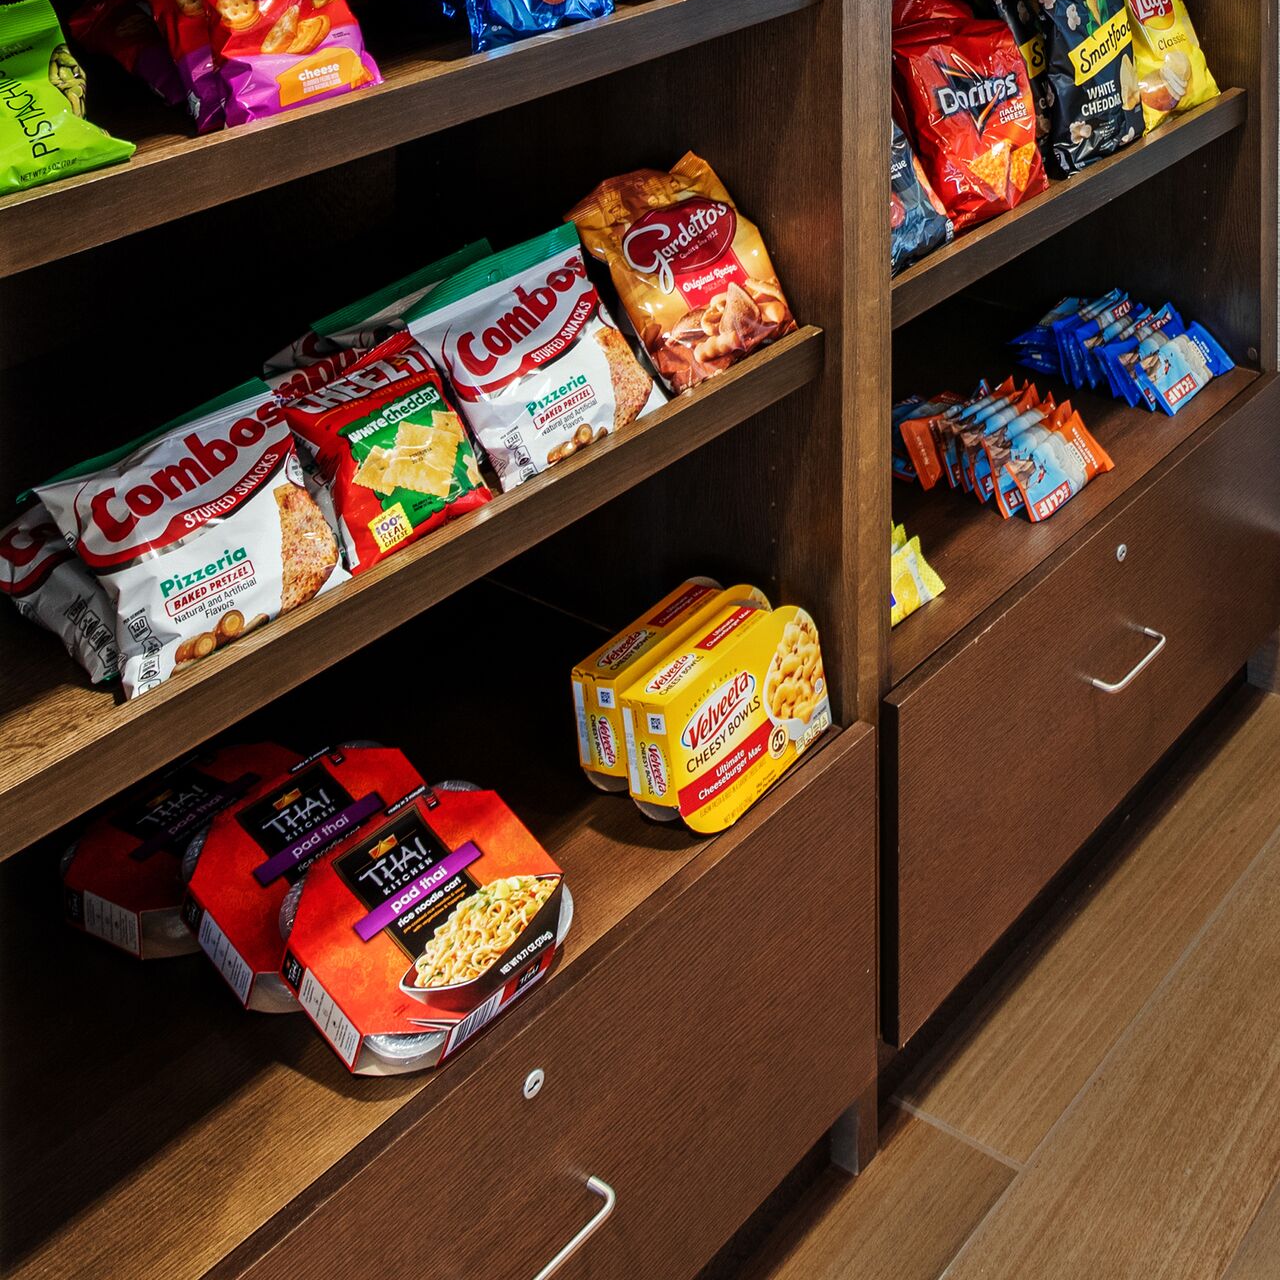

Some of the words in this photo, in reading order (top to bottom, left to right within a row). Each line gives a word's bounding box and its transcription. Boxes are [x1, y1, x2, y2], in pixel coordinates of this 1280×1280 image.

[299, 62, 340, 83] cheese
[937, 73, 1018, 116] Doritos
[1087, 80, 1116, 100] WHITE
[623, 203, 727, 295] Gardetto's
[683, 272, 714, 292] Original
[713, 264, 737, 278] Recipe
[455, 256, 586, 376] Combos
[531, 337, 566, 364] STUFFED
[560, 301, 591, 341] SNACKS
[526, 374, 587, 416] Pizzeria
[540, 405, 562, 424] BAKED
[564, 389, 590, 409] PRETZEL
[542, 419, 564, 436] Natural
[564, 414, 575, 423] and
[575, 400, 597, 415] Artificial
[563, 416, 584, 431] Flavors
[90, 400, 288, 542] Combos
[183, 494, 237, 530] STUFFED
[238, 452, 280, 497] SNACKS
[1037, 485, 1070, 517] CLIF
[160, 547, 247, 598] Pizzeria
[173, 587, 207, 611] BAKED
[209, 567, 249, 591] PRETZEL
[174, 606, 206, 625] Natural
[208, 593, 223, 608] and
[224, 577, 257, 599] Artificial
[205, 599, 235, 619] Flavors
[131, 620, 146, 633] 130
[652, 654, 689, 692] Velveeta
[688, 671, 749, 750] Velveeta
[686, 735, 727, 774] CHEESY
[728, 695, 761, 737] BOWLS
[649, 744, 666, 796] Velveeta
[698, 756, 747, 801] Cheeseburger
[747, 743, 762, 761] Mac
[716, 748, 745, 778] Ultimate
[285, 806, 336, 842] KITCHEN
[292, 832, 323, 860] pad
[322, 814, 349, 837] thai
[358, 836, 430, 887] THAI
[383, 857, 433, 896] KITCHEN
[390, 885, 421, 915] pad
[420, 865, 448, 890] thai
[397, 911, 415, 928] rice
[415, 890, 444, 914] noodle
[444, 877, 462, 893] cart
